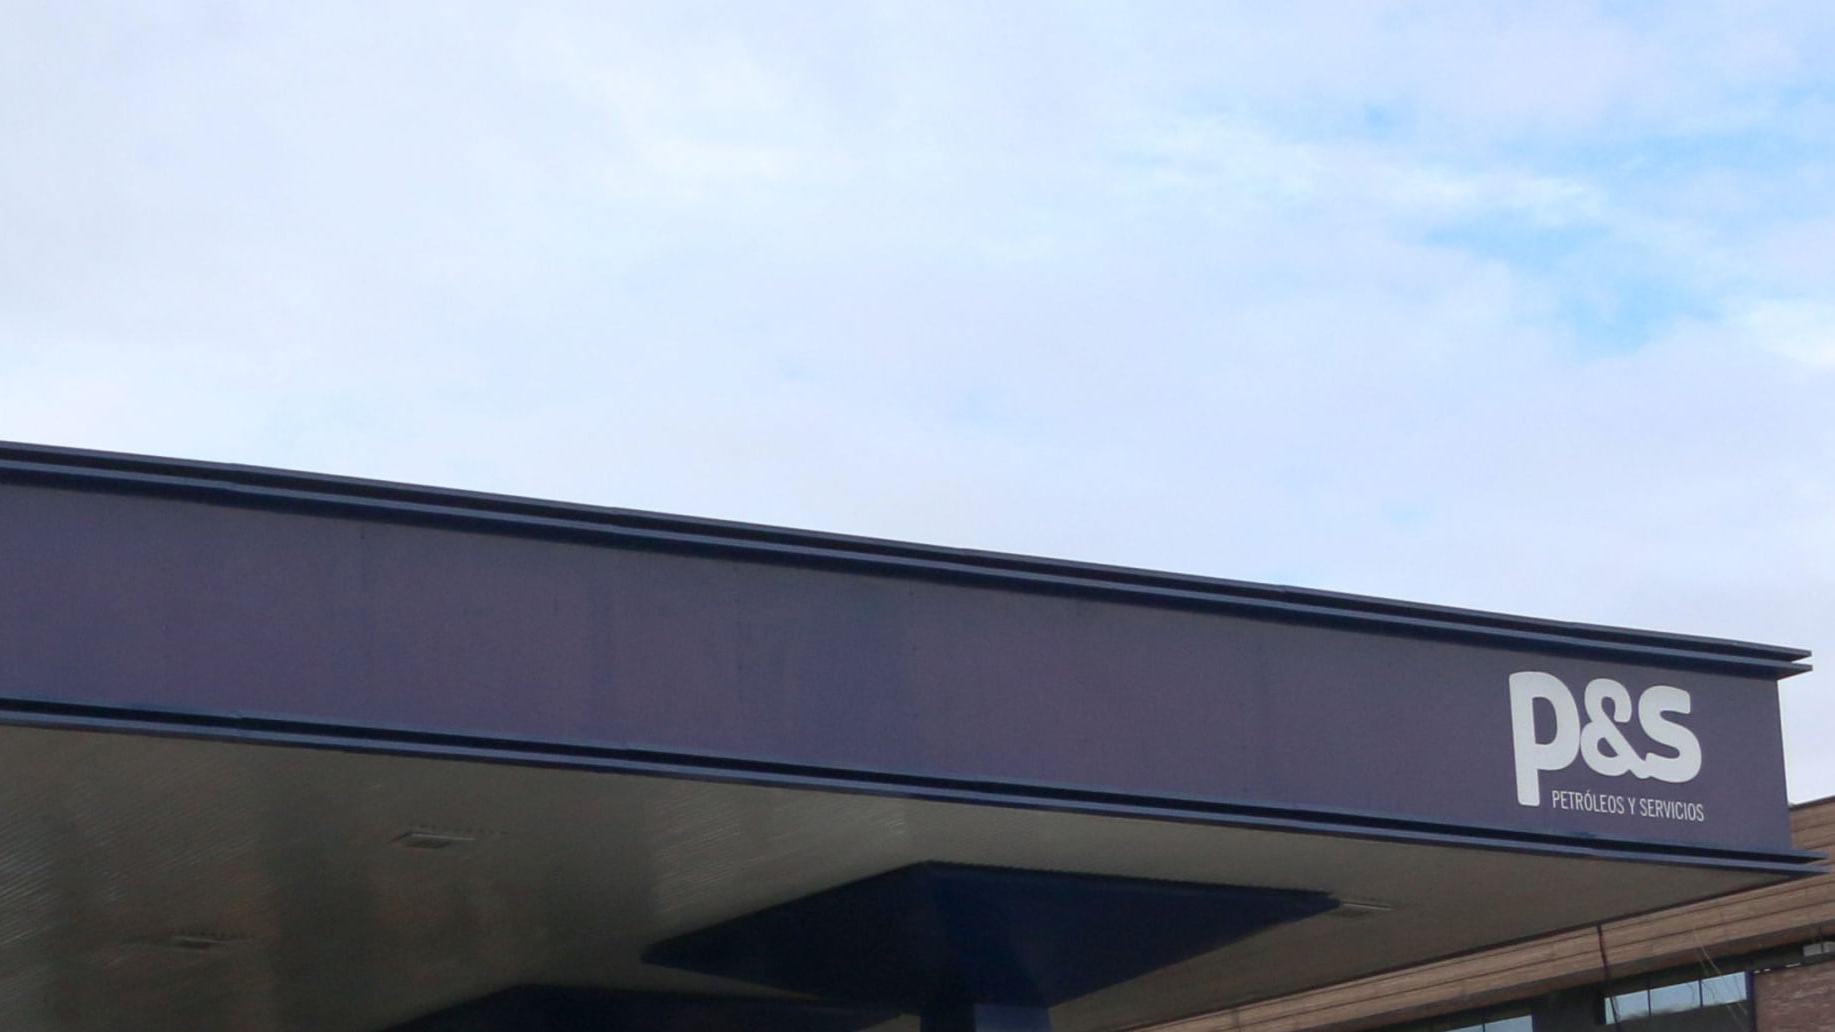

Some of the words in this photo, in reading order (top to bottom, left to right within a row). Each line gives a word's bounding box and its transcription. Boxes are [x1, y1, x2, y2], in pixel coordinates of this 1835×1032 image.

[1552, 789, 1624, 815] PETRÓLEOS
[1628, 798, 1636, 815] Y
[1640, 799, 1704, 822] SERVICIOS
